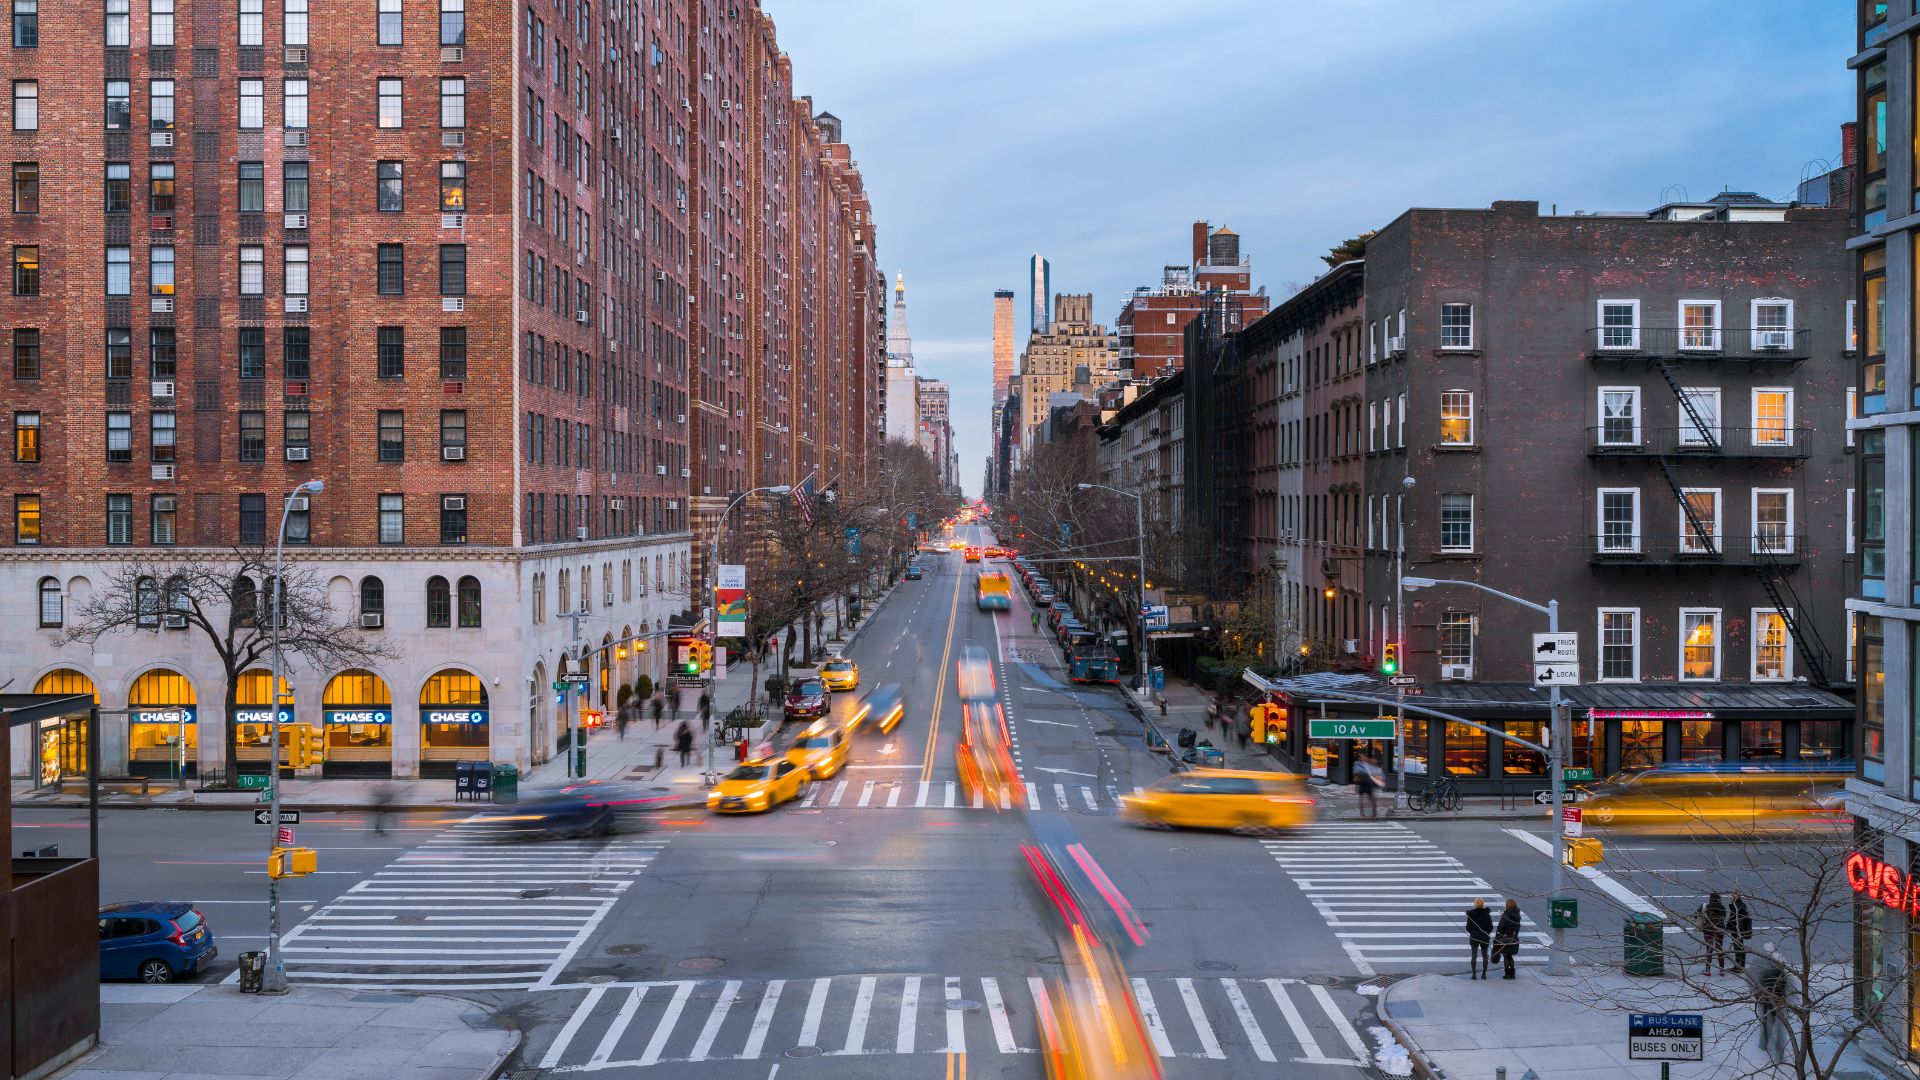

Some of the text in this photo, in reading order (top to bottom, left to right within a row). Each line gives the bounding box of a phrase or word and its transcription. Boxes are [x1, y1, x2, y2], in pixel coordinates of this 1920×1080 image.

[140, 712, 180, 722] CHASE
[236, 712, 274, 722] CHASE
[333, 712, 373, 722] CHASE
[430, 712, 470, 722] CHASE
[1333, 724, 1366, 734] 10 Av
[1567, 770, 1578, 779] 10
[243, 776, 254, 785] 10
[1648, 1016, 1698, 1025] BUS LANE
[1648, 1028, 1684, 1036] AHEAD
[1633, 1043, 1698, 1053] BUSES ONLY
